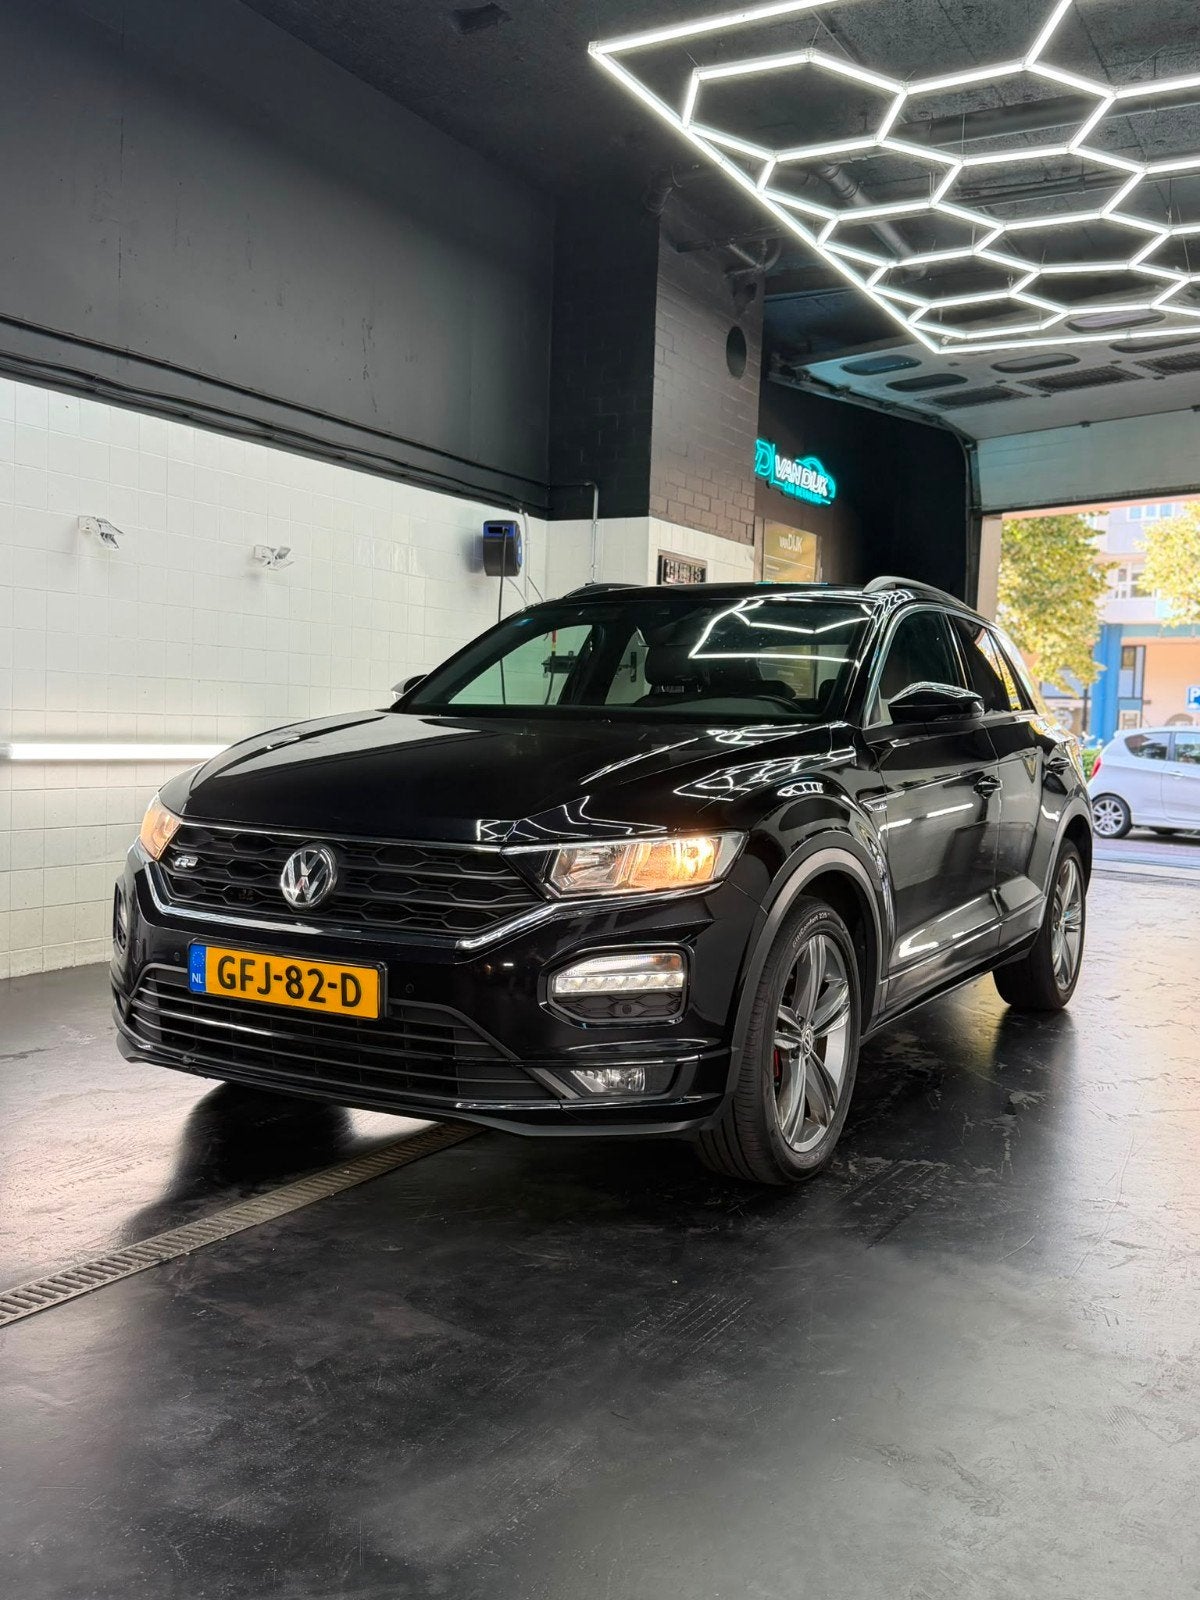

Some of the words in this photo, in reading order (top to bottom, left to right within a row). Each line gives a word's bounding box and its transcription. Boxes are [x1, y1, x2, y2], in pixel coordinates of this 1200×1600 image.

[775, 454, 801, 485] VAN
[191, 972, 203, 984] NL
[217, 955, 362, 1008] GFJ-82-D
